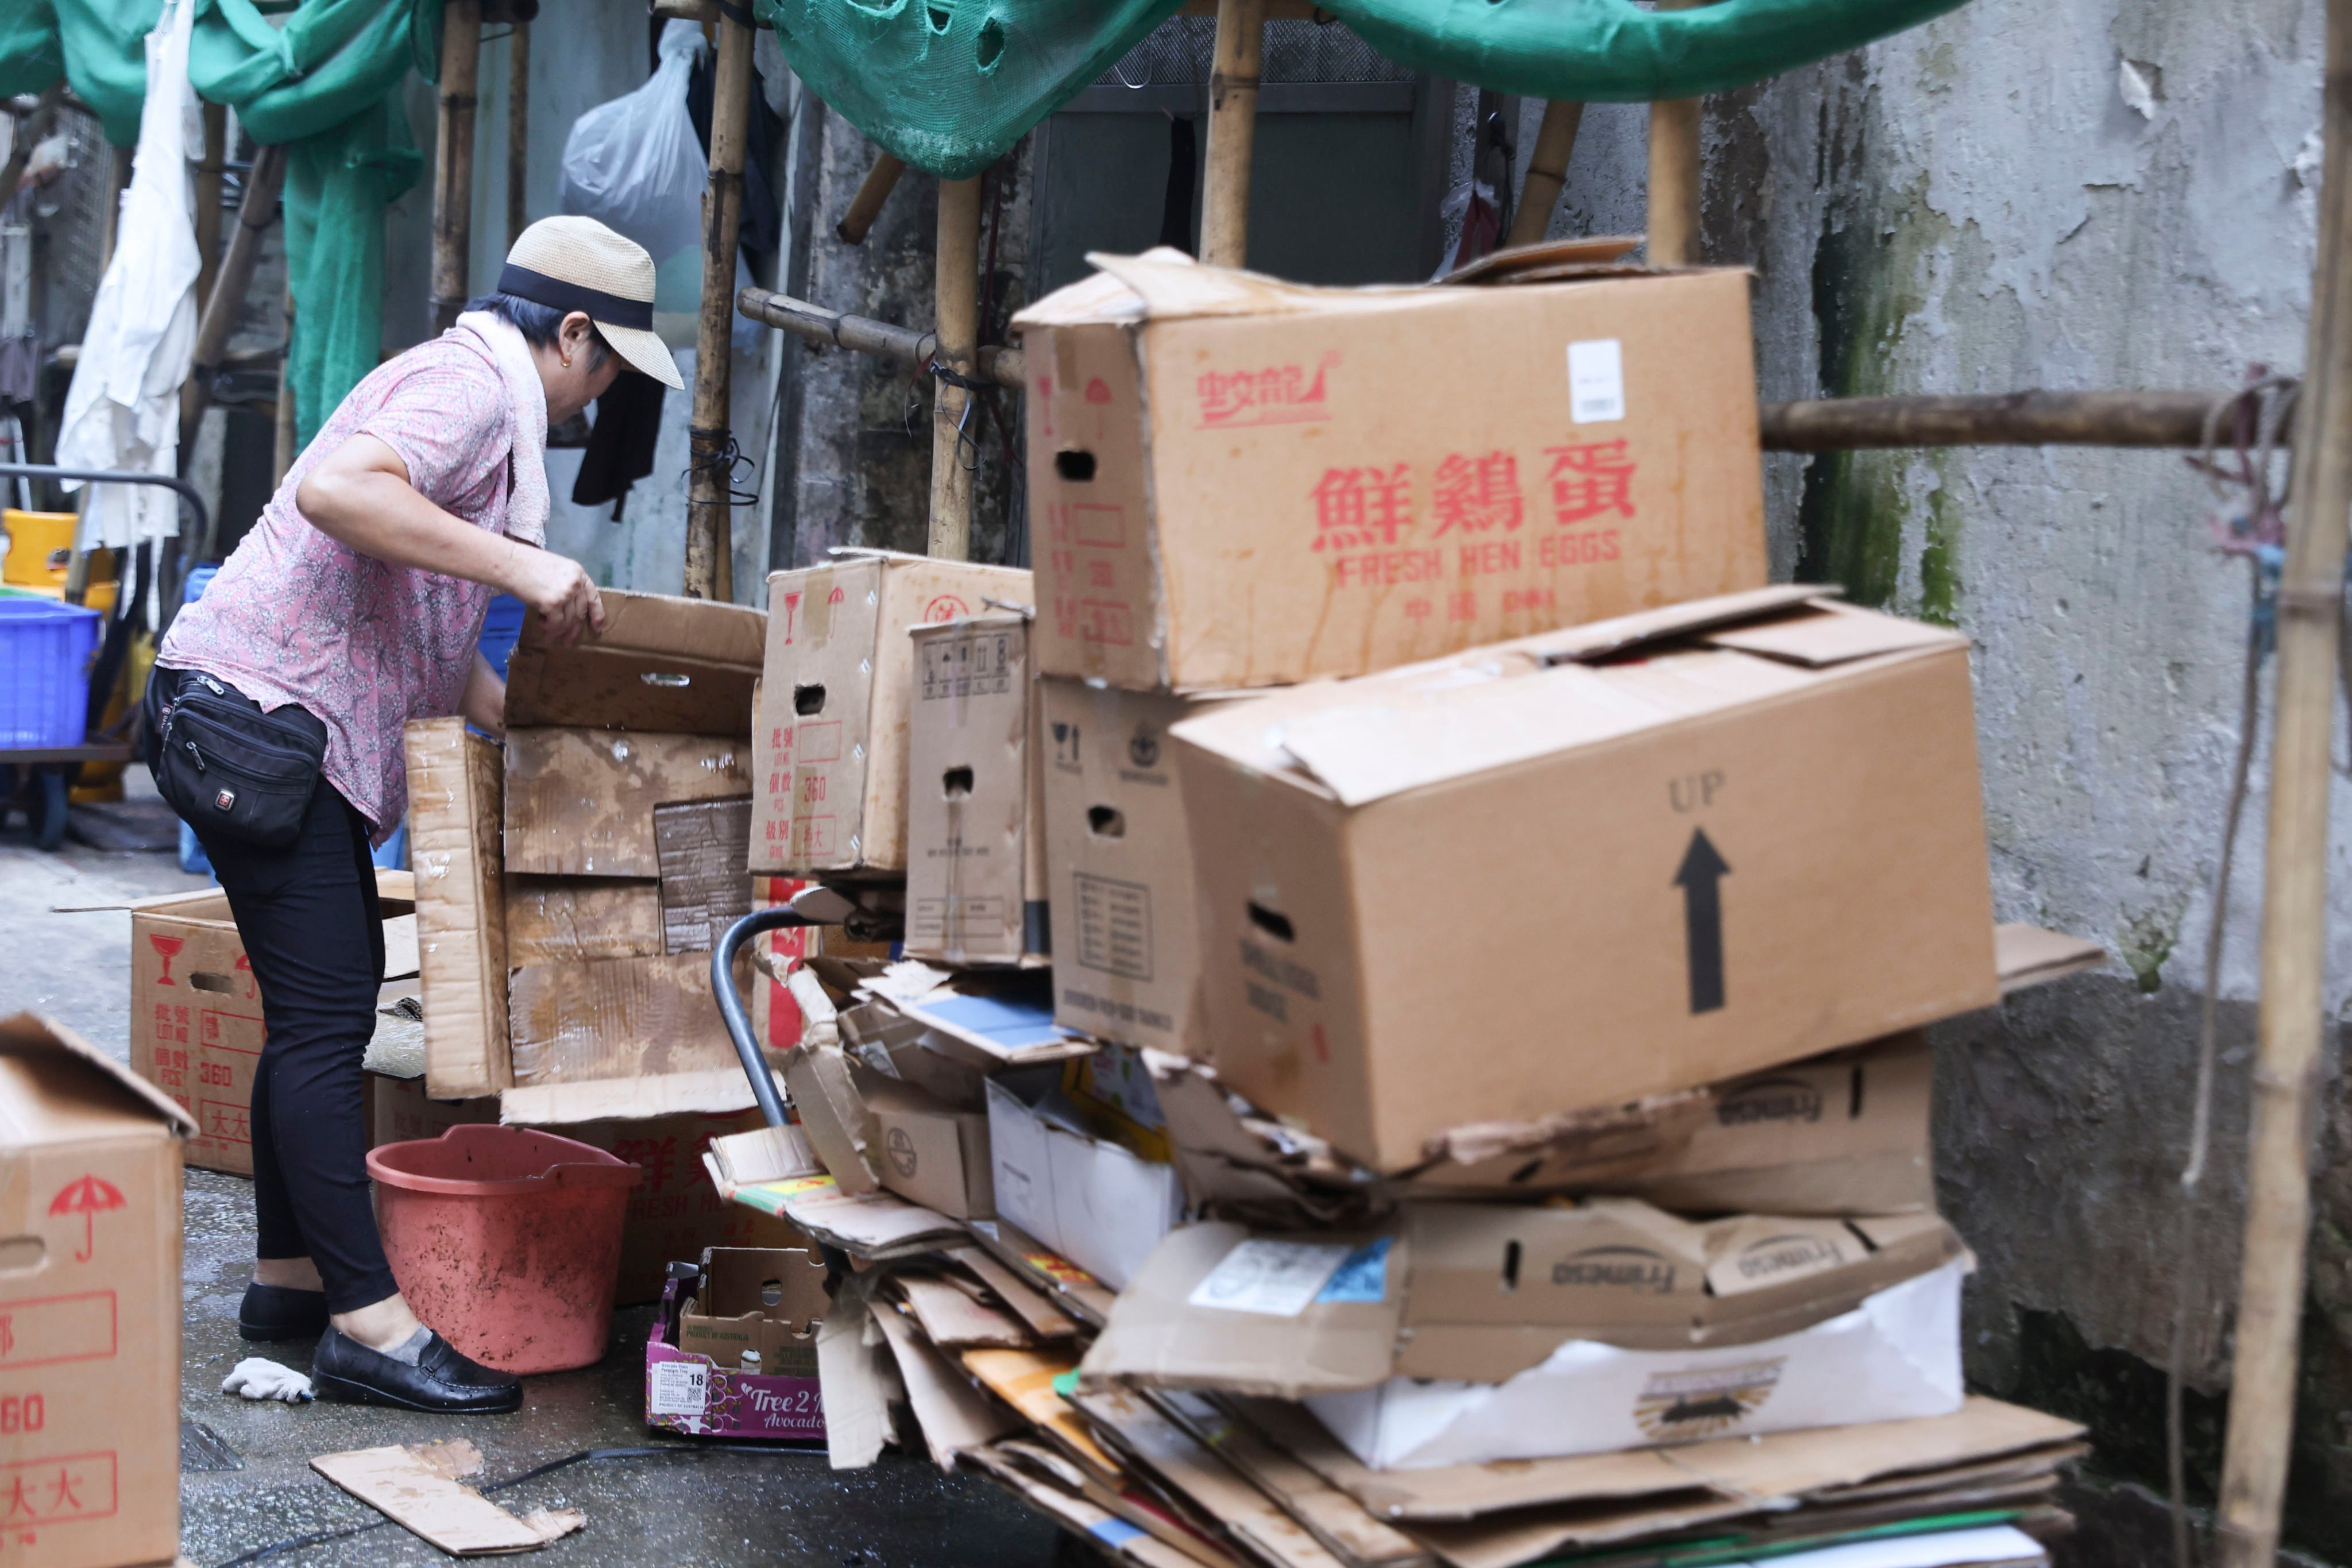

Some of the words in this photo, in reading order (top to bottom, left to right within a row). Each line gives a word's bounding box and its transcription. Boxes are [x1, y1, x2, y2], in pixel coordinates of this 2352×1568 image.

[1339, 549, 1443, 588] FRESH
[1461, 542, 1521, 576] HEN
[1540, 530, 1622, 569] EGGS
[805, 777, 826, 802] 360
[1669, 770, 1725, 812] UP
[199, 1062, 232, 1087] 360
[211, 1109, 249, 1137] 大大
[686, 1331, 711, 1339] PRODUCT
[720, 1332, 749, 1342] AUSTRALIA
[690, 1373, 704, 1386] 18
[751, 1389, 793, 1412] Tree
[795, 1391, 810, 1413] 2
